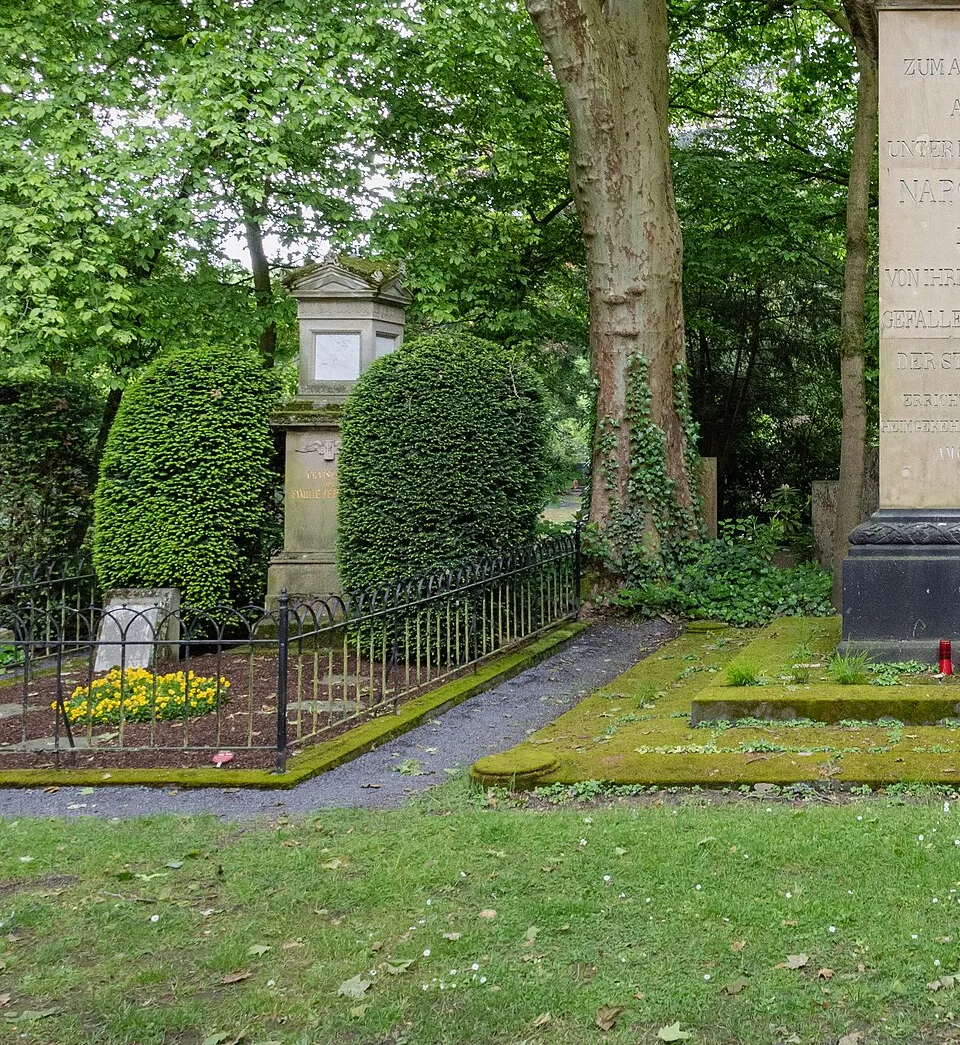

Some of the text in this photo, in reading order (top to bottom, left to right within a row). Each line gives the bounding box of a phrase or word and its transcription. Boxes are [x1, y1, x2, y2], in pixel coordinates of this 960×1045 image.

[904, 58, 944, 76] ZUM
[887, 140, 954, 158] UNTER
[884, 268, 919, 287] VON
[896, 351, 937, 370] DER
